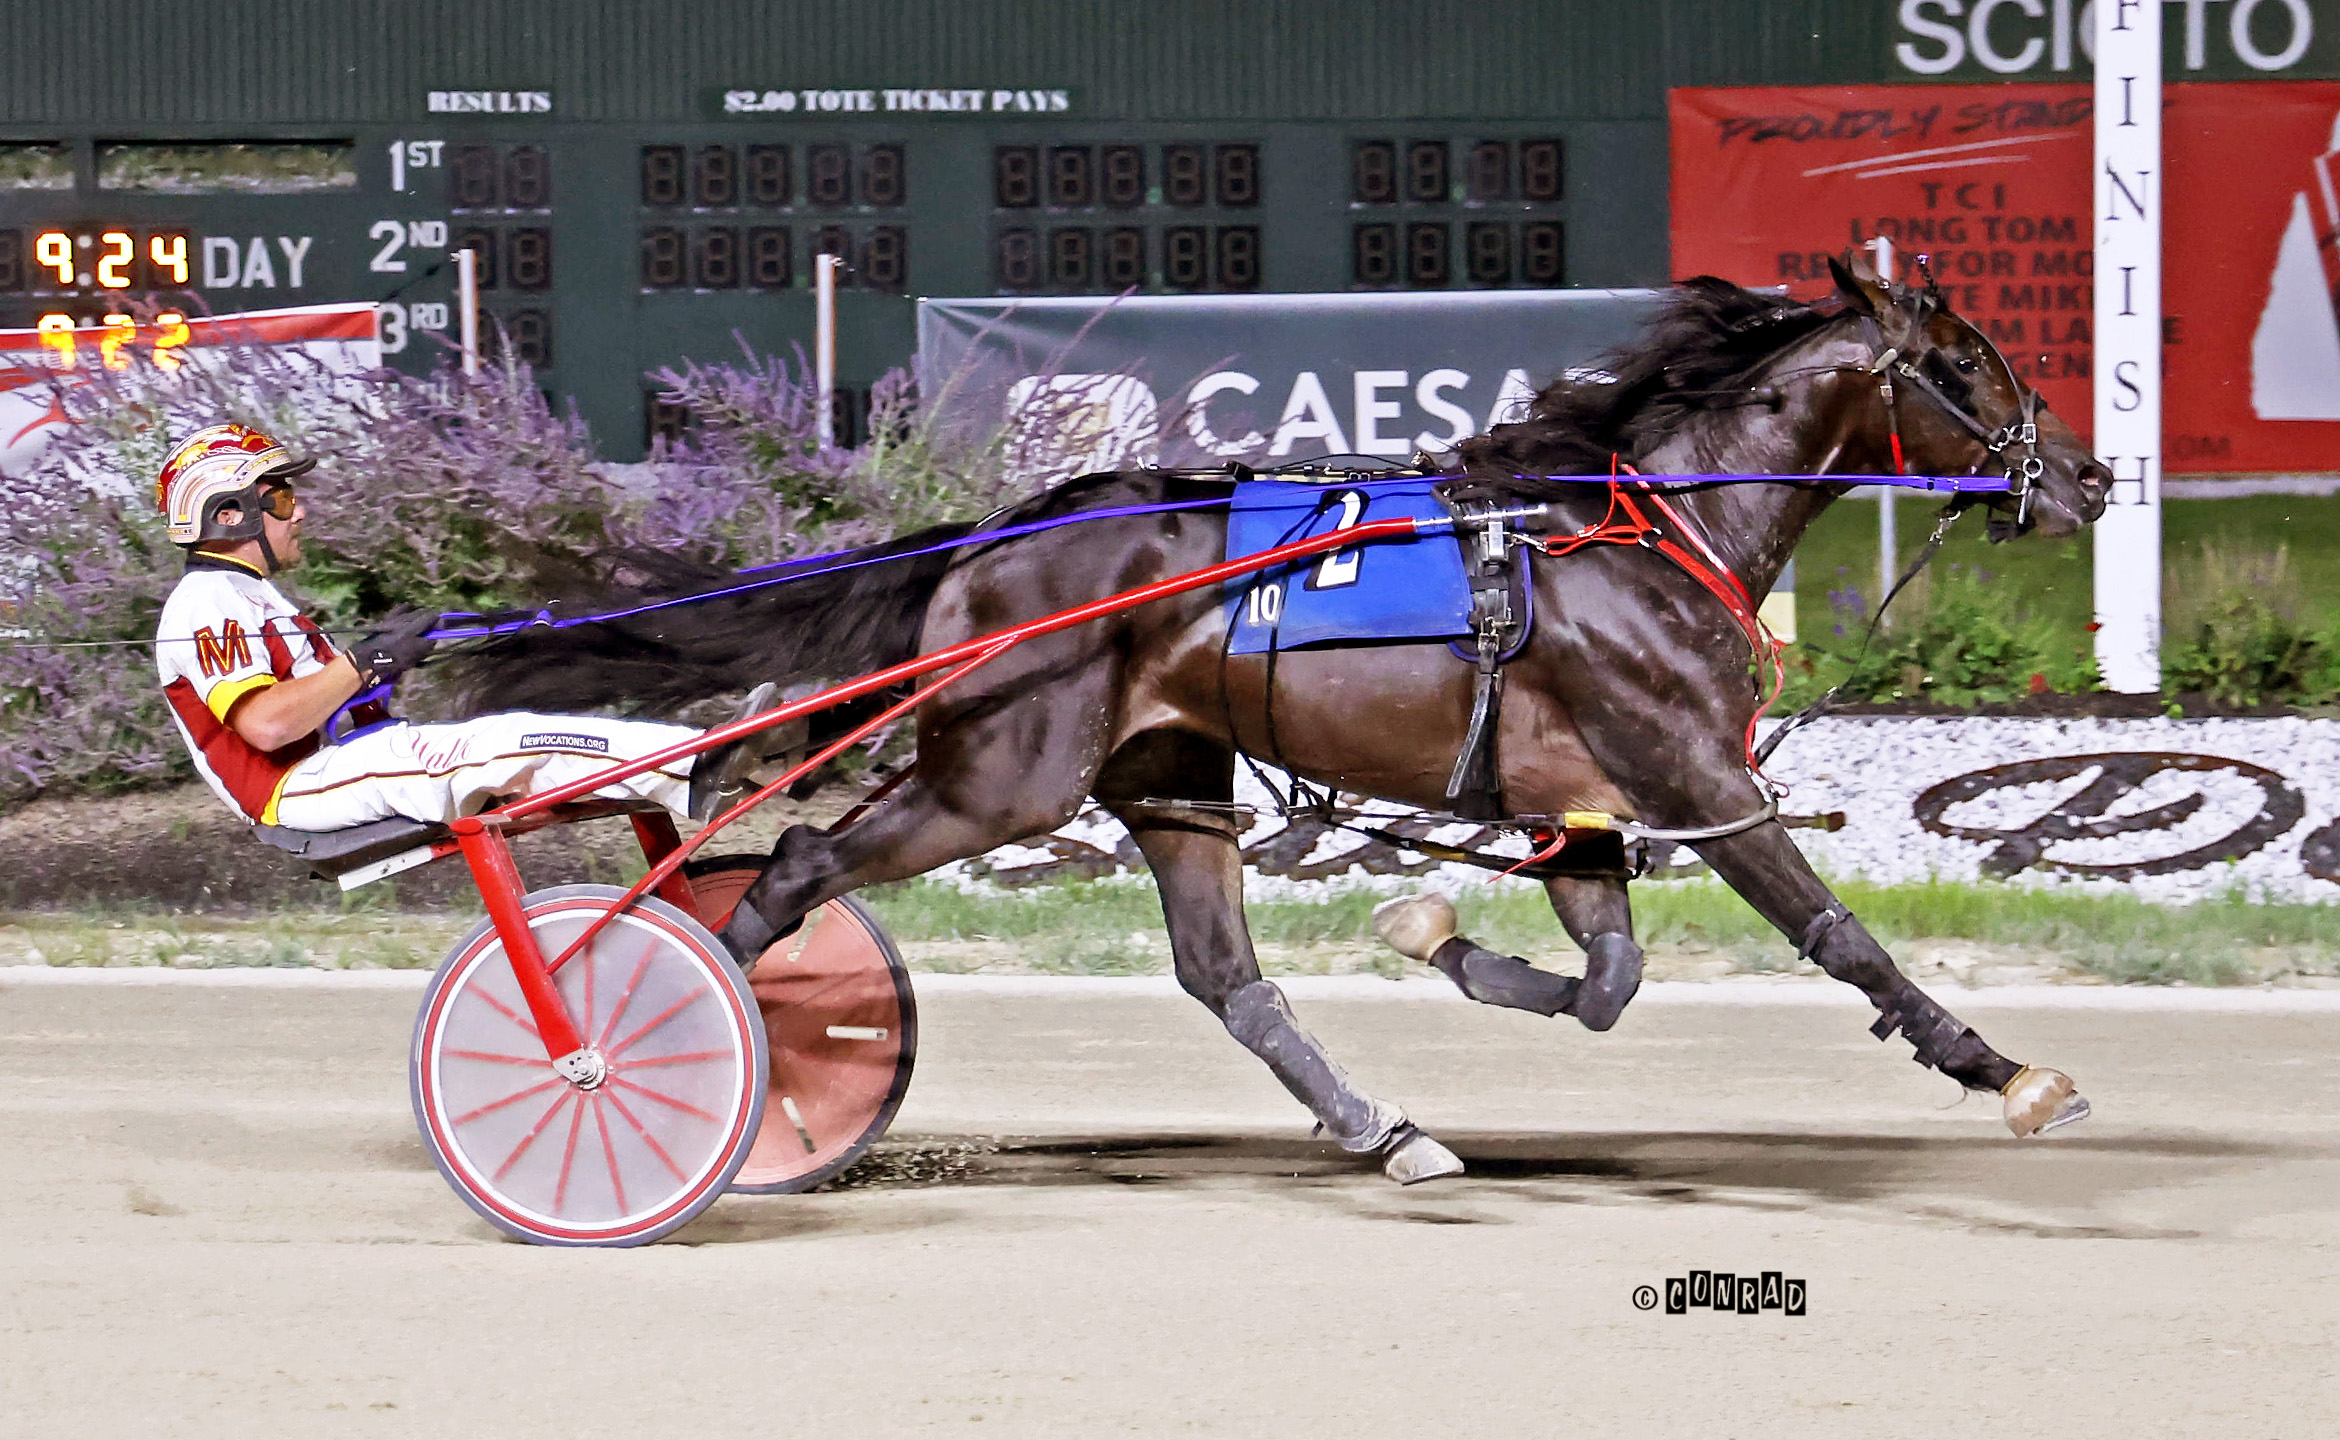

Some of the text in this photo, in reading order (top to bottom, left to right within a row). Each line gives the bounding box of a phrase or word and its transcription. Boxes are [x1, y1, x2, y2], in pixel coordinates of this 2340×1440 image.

[1896, 0, 2313, 74] SCITO
[428, 91, 552, 112] RESULTS
[724, 90, 1069, 112] $2.00 TOTE TICKET PAYS
[389, 140, 446, 191] 1ST
[369, 220, 448, 272] 2ND
[1850, 217, 2077, 246] LONG TOM
[35, 231, 190, 289] 9:24
[203, 236, 312, 288] DAY
[1933, 251, 2015, 279] FOR
[2001, 284, 2094, 311] MIK
[1186, 367, 1540, 456] CAESA
[1248, 583, 1281, 624] 10
[193, 617, 253, 679] M
